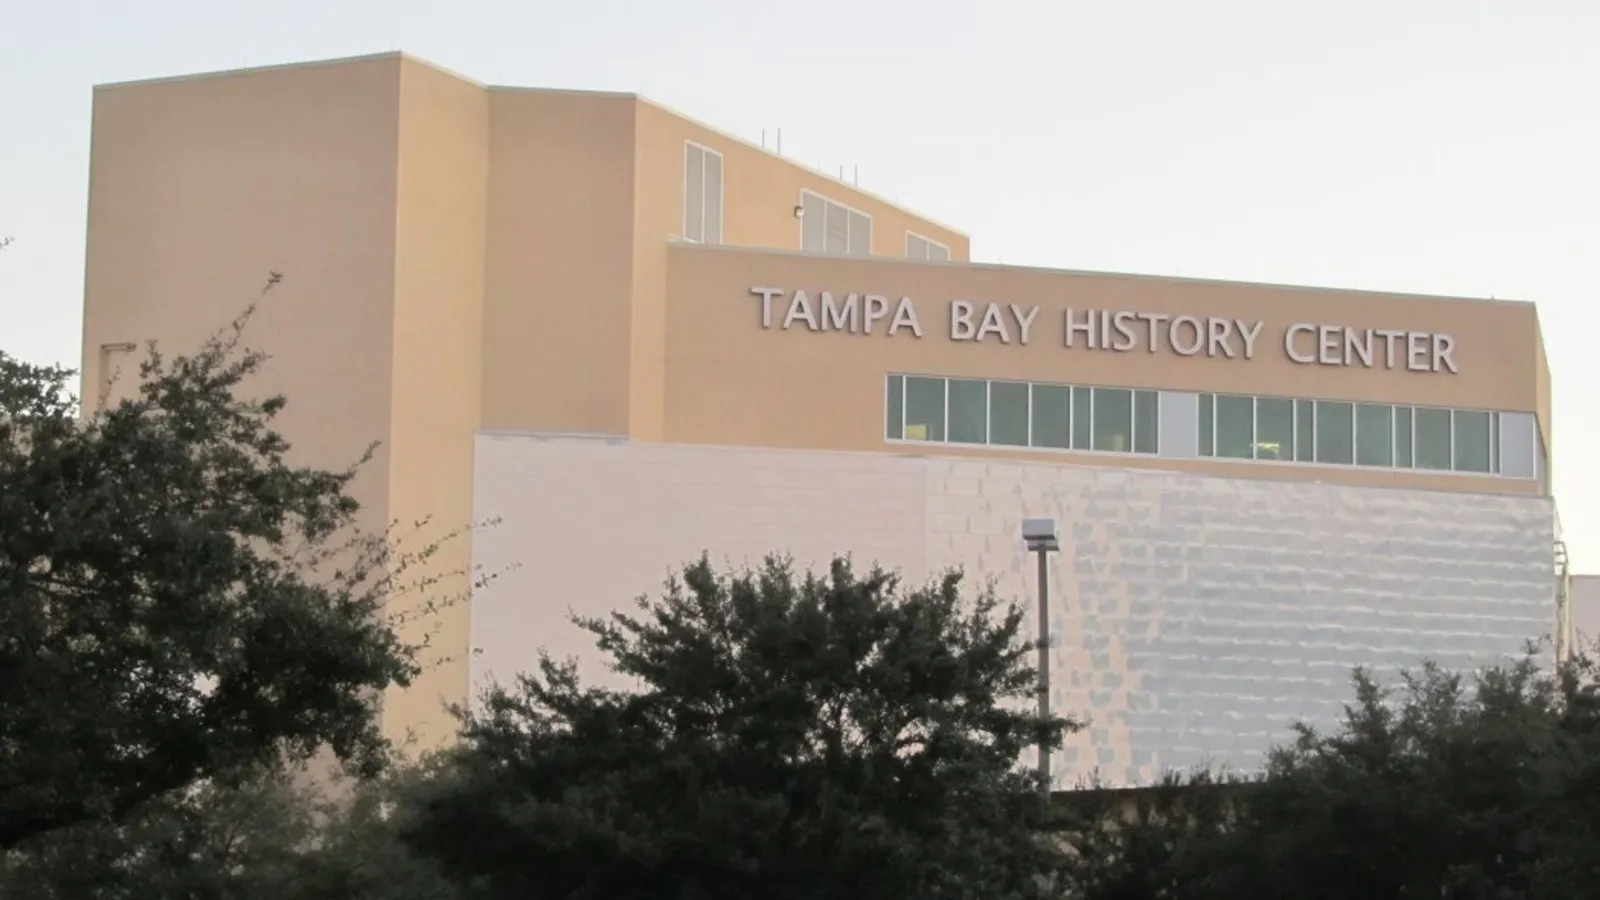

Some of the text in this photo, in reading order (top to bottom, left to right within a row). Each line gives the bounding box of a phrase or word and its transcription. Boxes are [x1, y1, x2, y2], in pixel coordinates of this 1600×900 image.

[750, 286, 1459, 374] TAMPA BAY HISTORY CENTER
